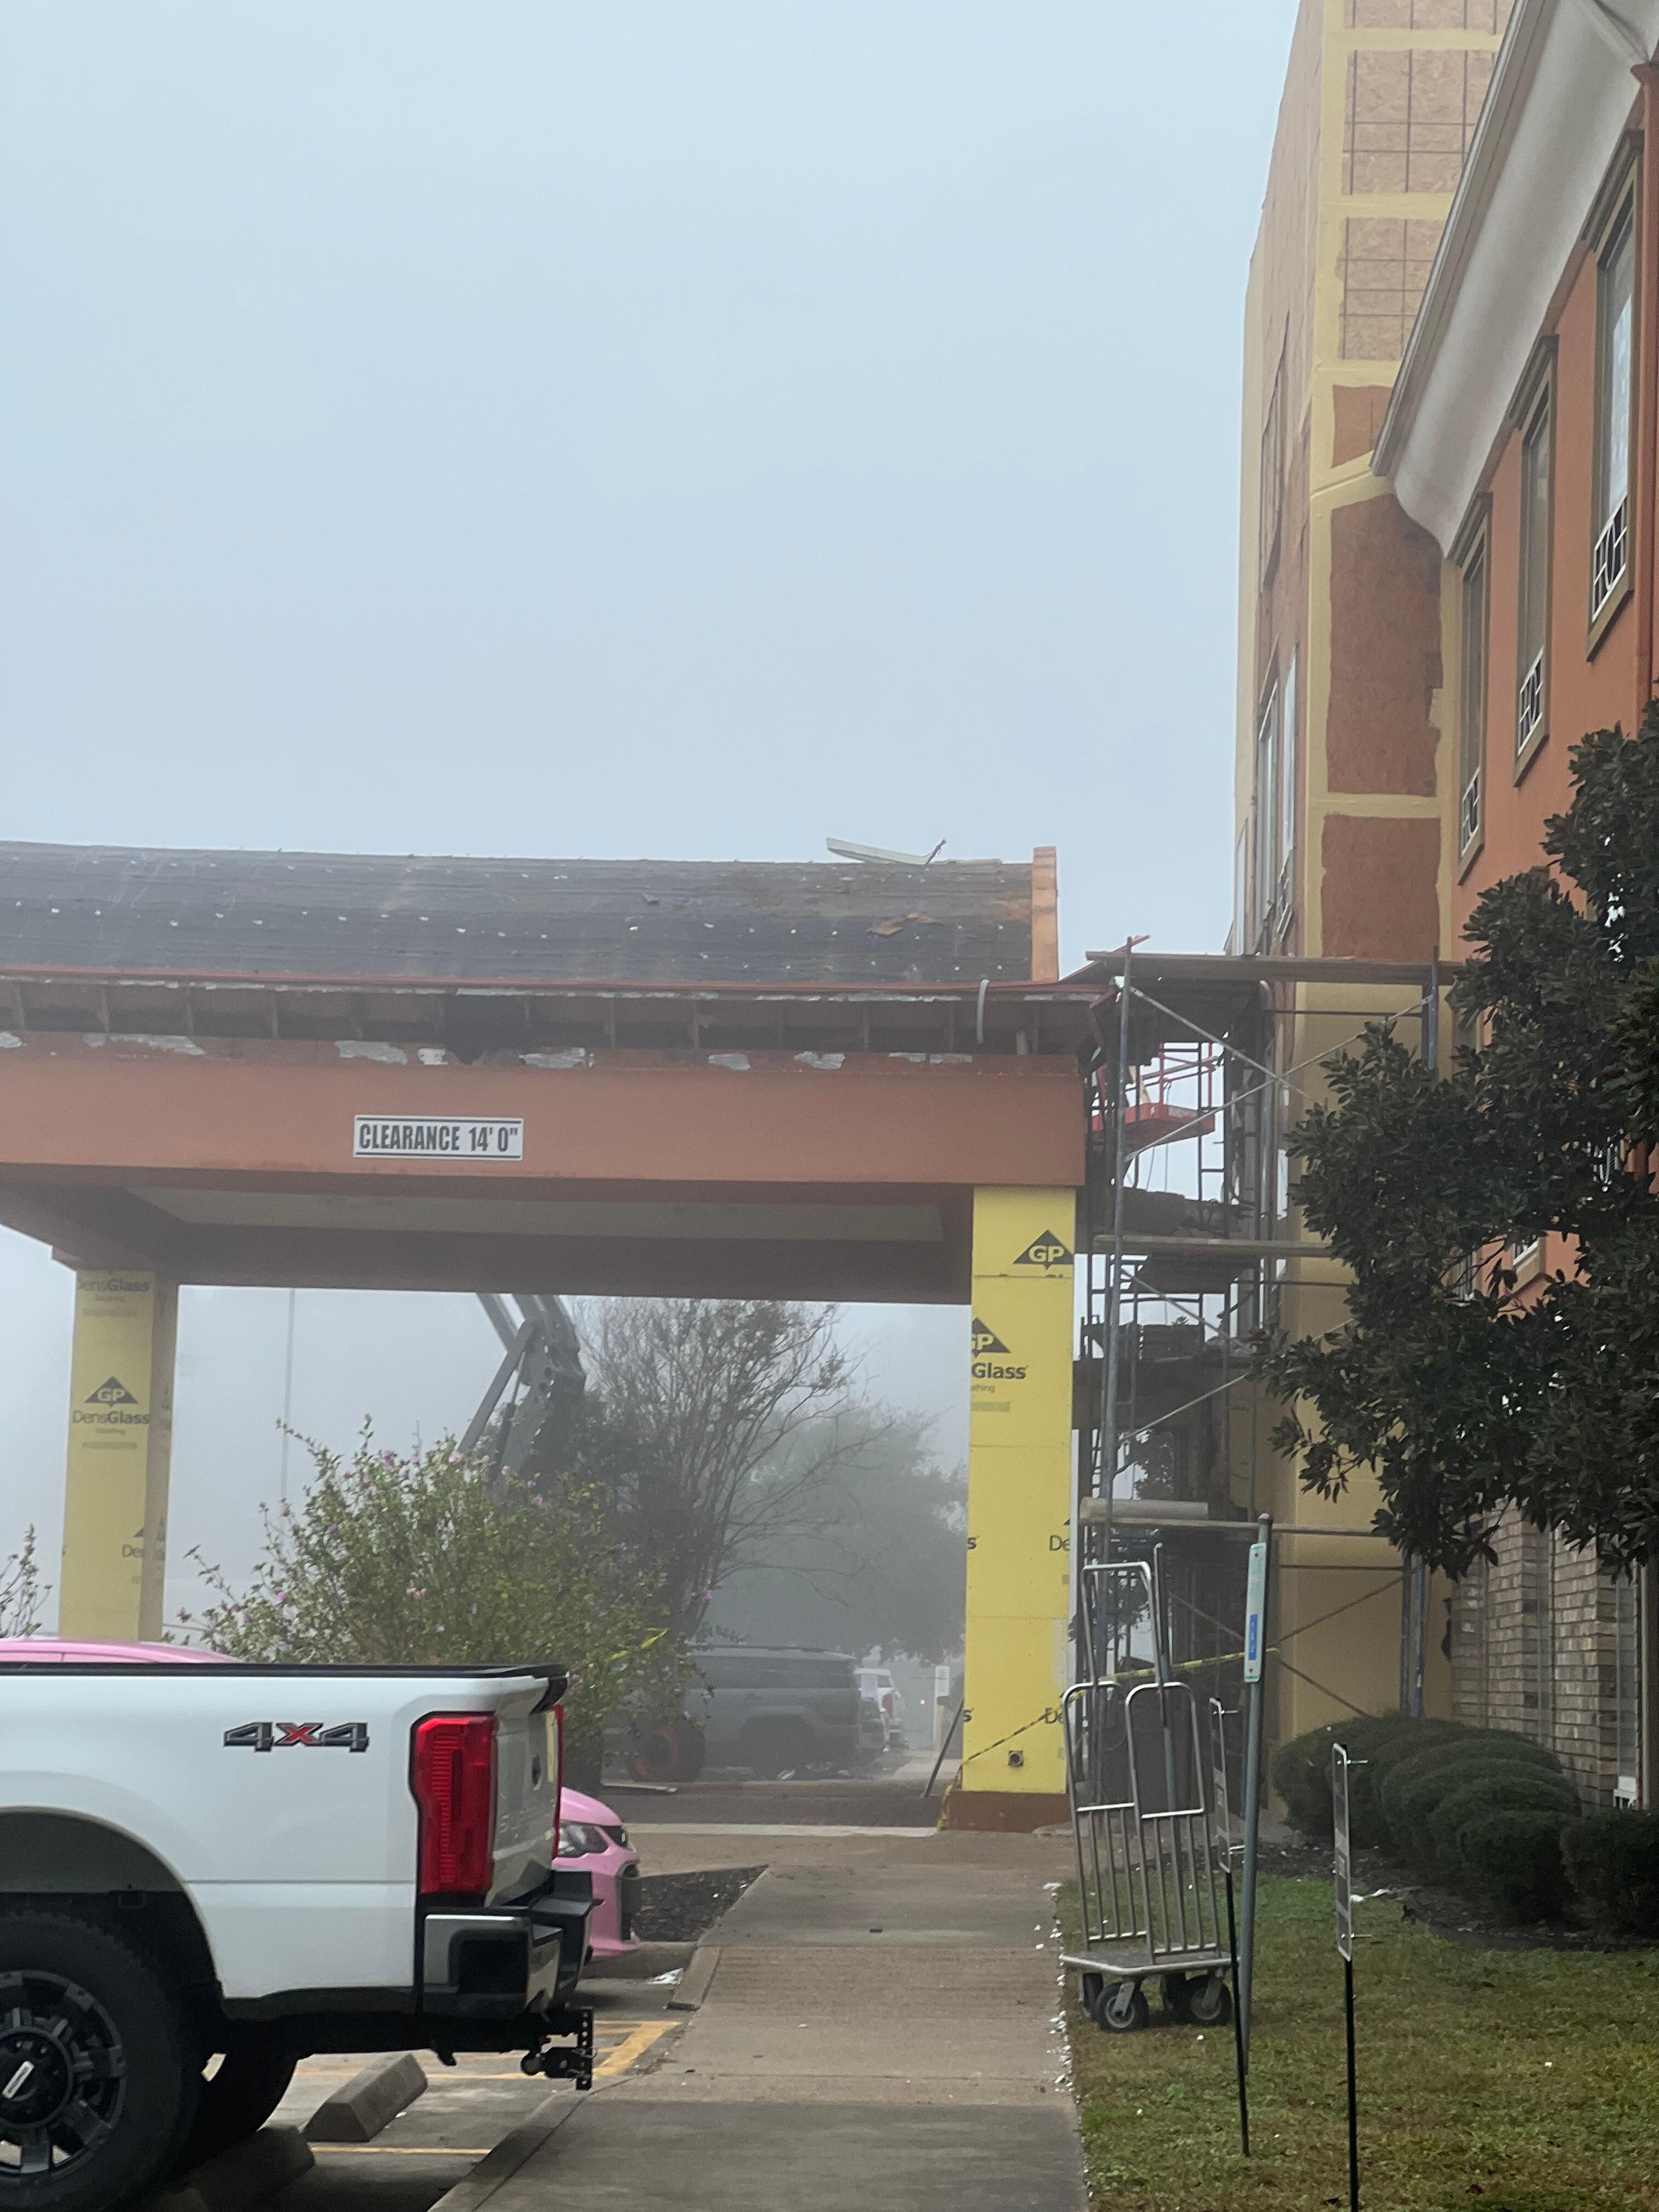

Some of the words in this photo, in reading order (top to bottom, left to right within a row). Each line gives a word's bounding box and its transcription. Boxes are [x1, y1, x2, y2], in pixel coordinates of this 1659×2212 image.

[359, 1124, 460, 1150] CLEARANCE
[468, 1127, 493, 1151] 14'
[1029, 1245, 1064, 1262] GP
[97, 1387, 126, 1402] GP
